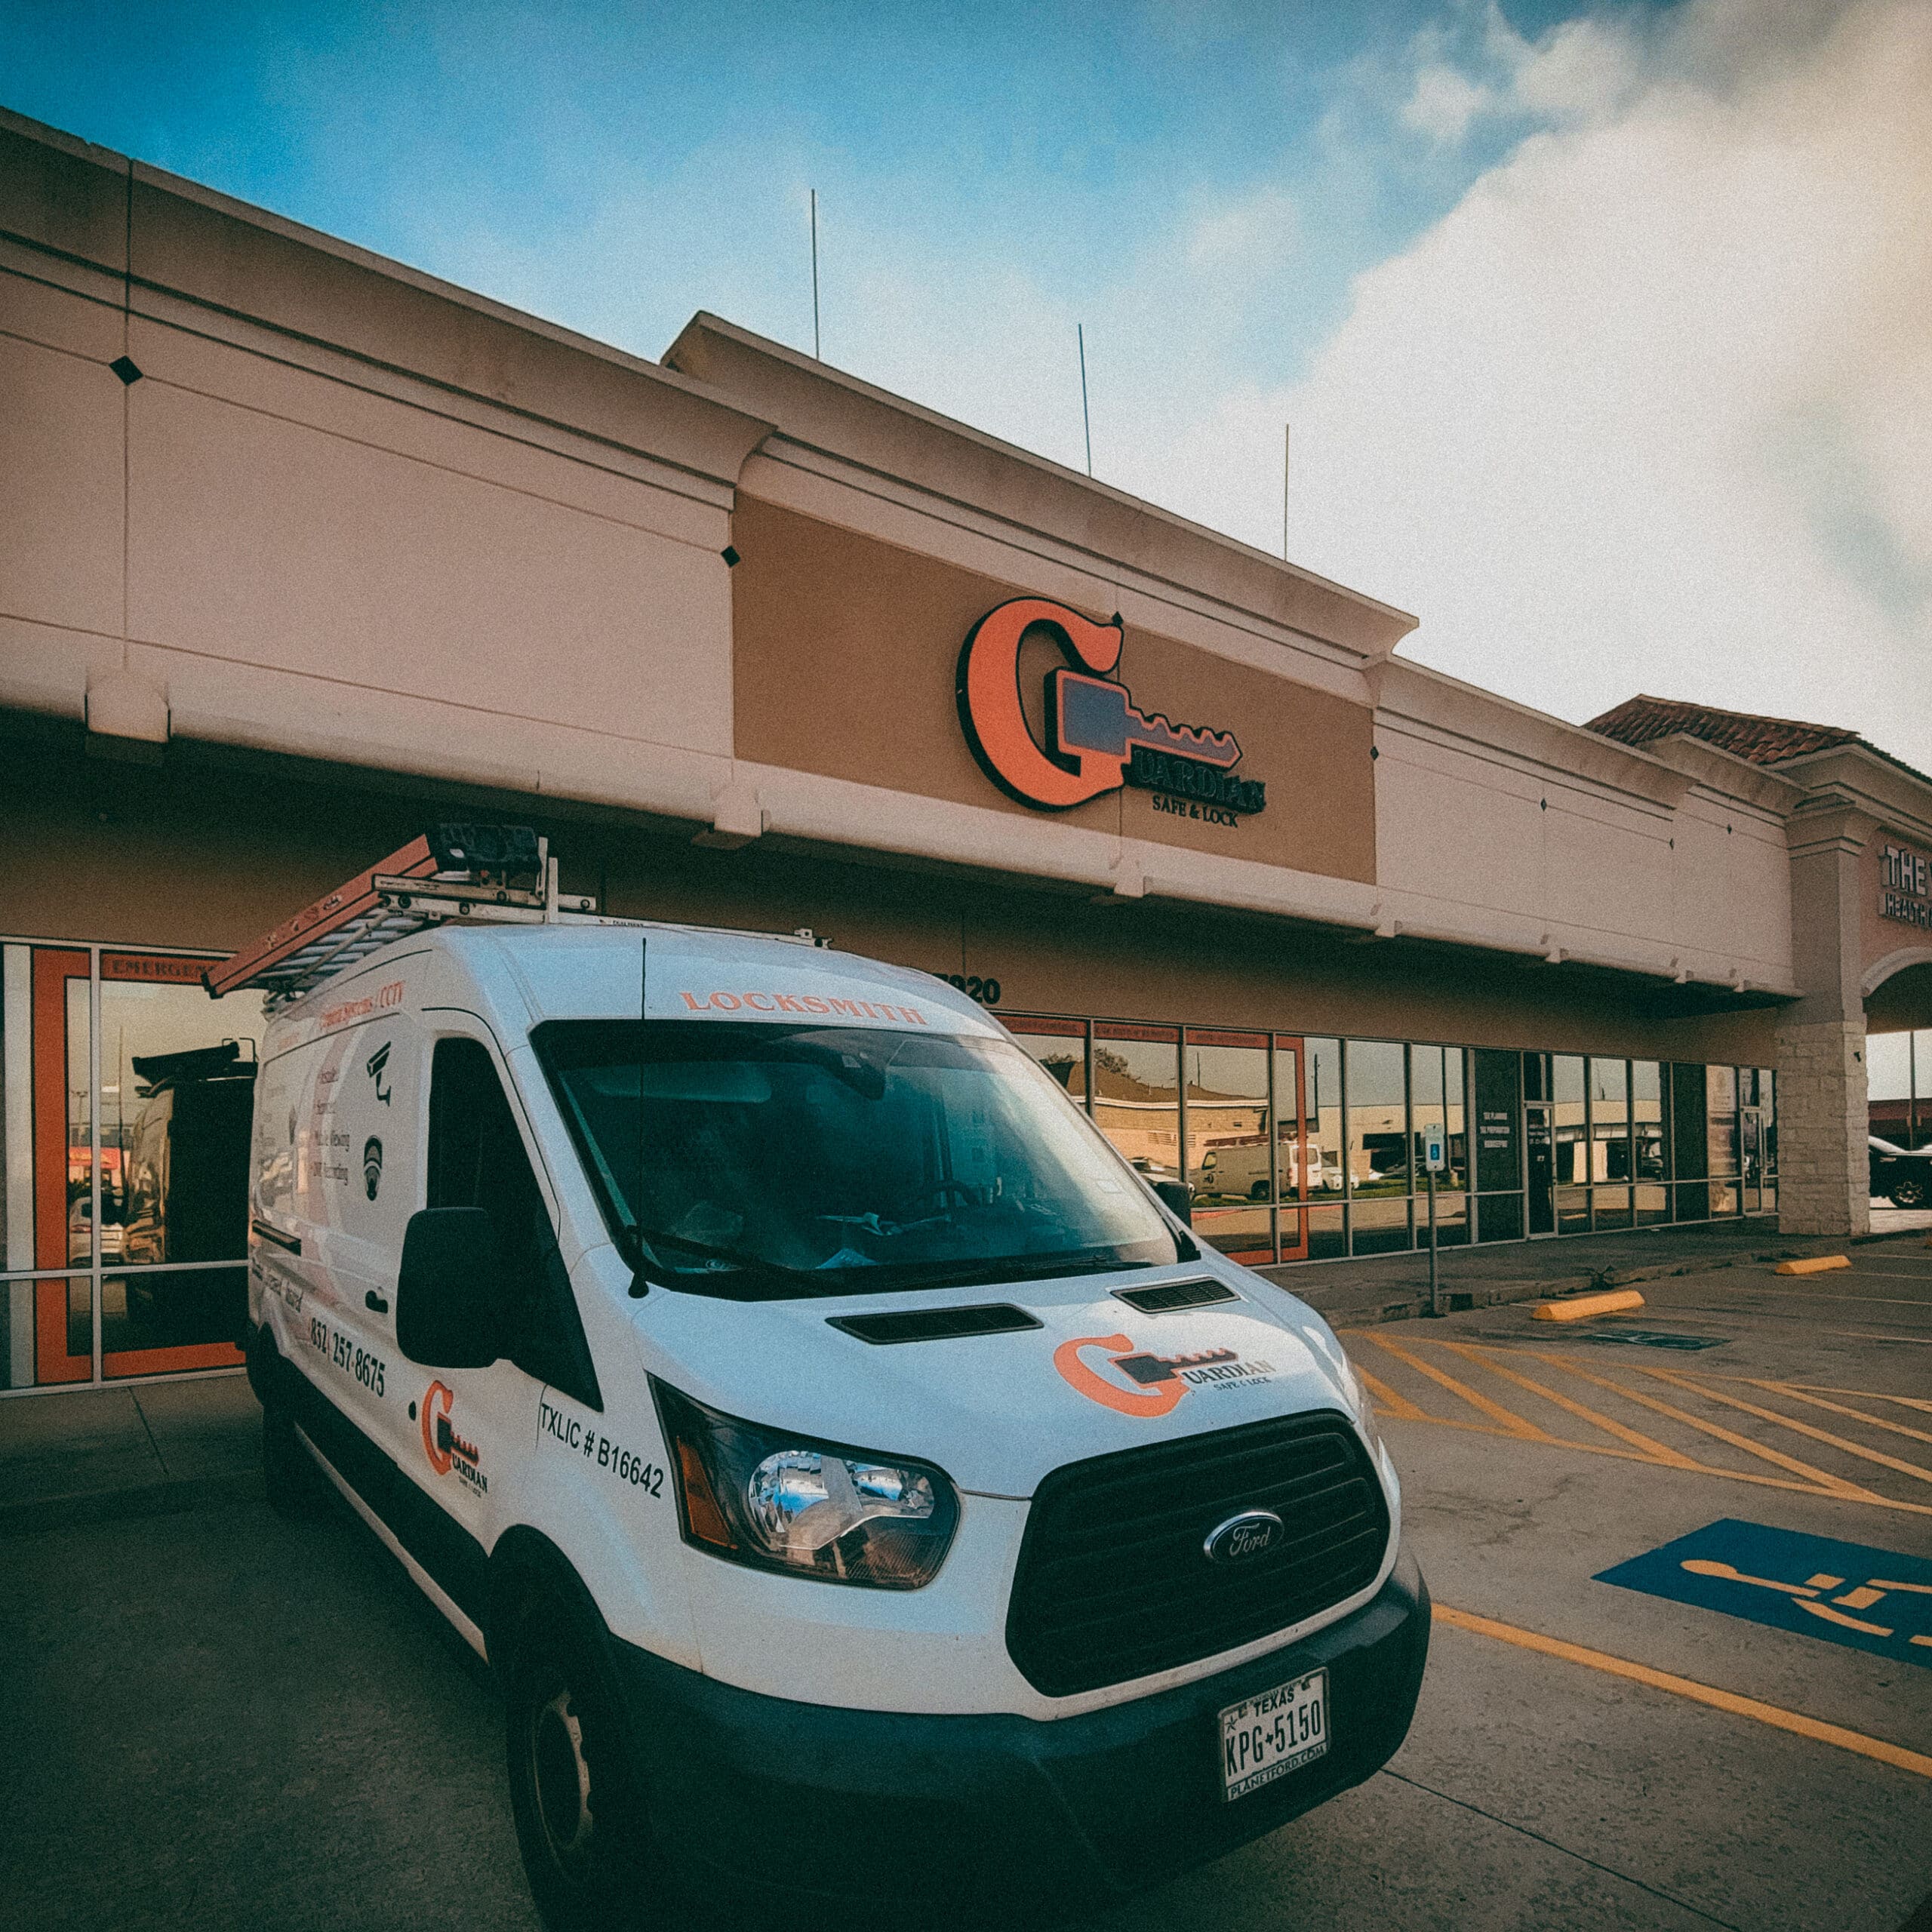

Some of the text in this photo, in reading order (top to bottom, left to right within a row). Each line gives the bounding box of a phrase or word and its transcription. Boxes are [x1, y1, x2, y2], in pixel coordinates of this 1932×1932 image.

[1152, 795, 1238, 828] SAFE & LOCK
[1884, 844, 1927, 896] THE
[680, 991, 928, 1026] LOCKSMITH
[1214, 1382, 1240, 1391] SAFE
[541, 1403, 664, 1499] TXLIC # B16642
[1229, 1523, 1271, 1557] Ford
[1254, 1687, 1295, 1717] TEXAS
[1230, 1746, 1324, 1799] PLANETFORD.COM
